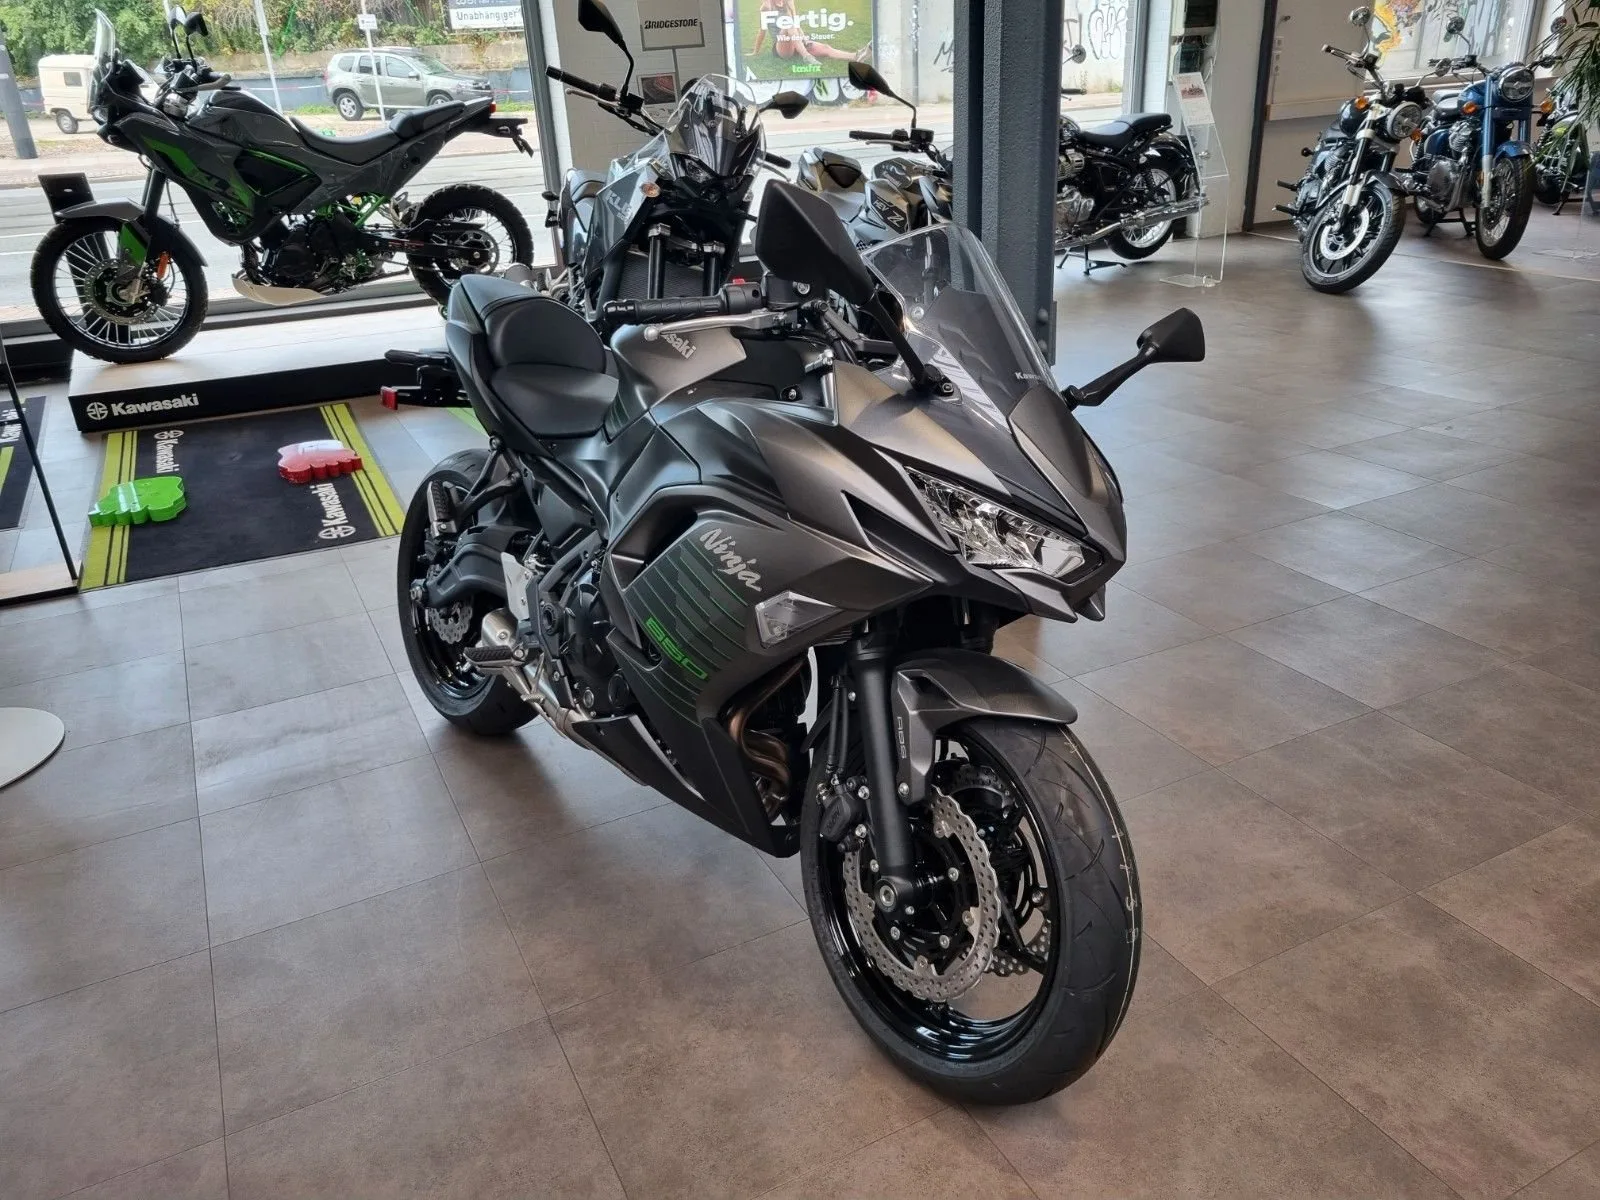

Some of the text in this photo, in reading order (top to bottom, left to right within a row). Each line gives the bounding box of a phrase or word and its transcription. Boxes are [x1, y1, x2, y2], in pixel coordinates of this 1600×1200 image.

[644, 18, 699, 29] BRIDGESTONE
[760, 8, 855, 32] Fertig.
[661, 333, 697, 359] saki
[110, 393, 200, 416] Kawasaki
[156, 438, 180, 474] Kawasaki
[309, 482, 349, 527] Kawasaki
[699, 527, 763, 592] Ninja
[645, 616, 709, 680] 650
